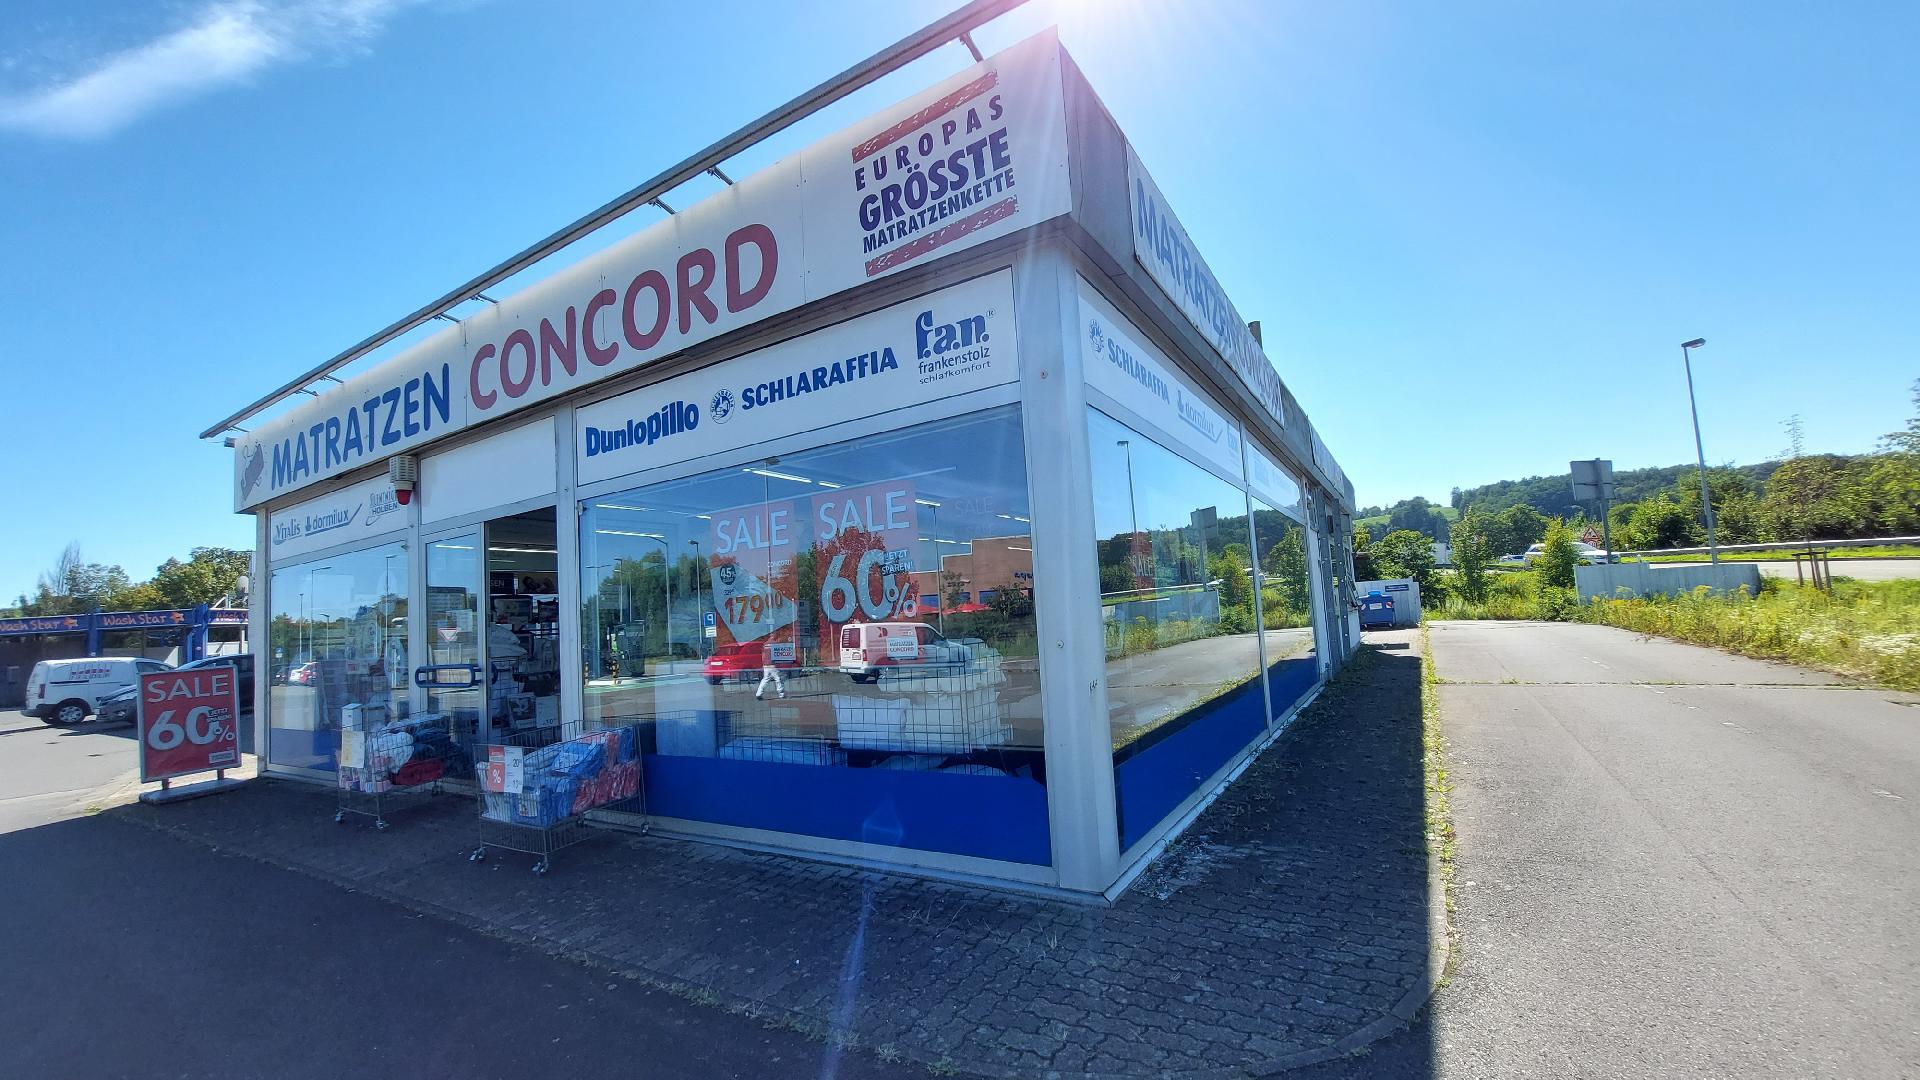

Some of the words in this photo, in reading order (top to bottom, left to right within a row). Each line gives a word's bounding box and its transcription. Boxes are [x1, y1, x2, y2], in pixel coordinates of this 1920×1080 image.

[854, 94, 1003, 192] EUROPAS
[859, 126, 1011, 232] GRÖSSTE
[863, 168, 1016, 254] MATRATZENKETTE
[1137, 177, 1232, 348] MATRATZEN
[271, 362, 450, 491] MATRATZEN
[470, 223, 779, 410] CONCORD
[918, 346, 990, 374] frankenstolz
[919, 361, 991, 384] schlafkomfort
[1107, 338, 1170, 404] SCHLARAFFIA
[585, 400, 699, 458] Dunlopillo
[742, 347, 898, 410] SCHLARAFFIA
[313, 509, 349, 530] dormilux
[716, 510, 789, 554] SALE
[819, 490, 910, 541] SALE
[104, 613, 136, 626] Wash
[139, 612, 166, 625] Star
[147, 674, 229, 703] SALE
